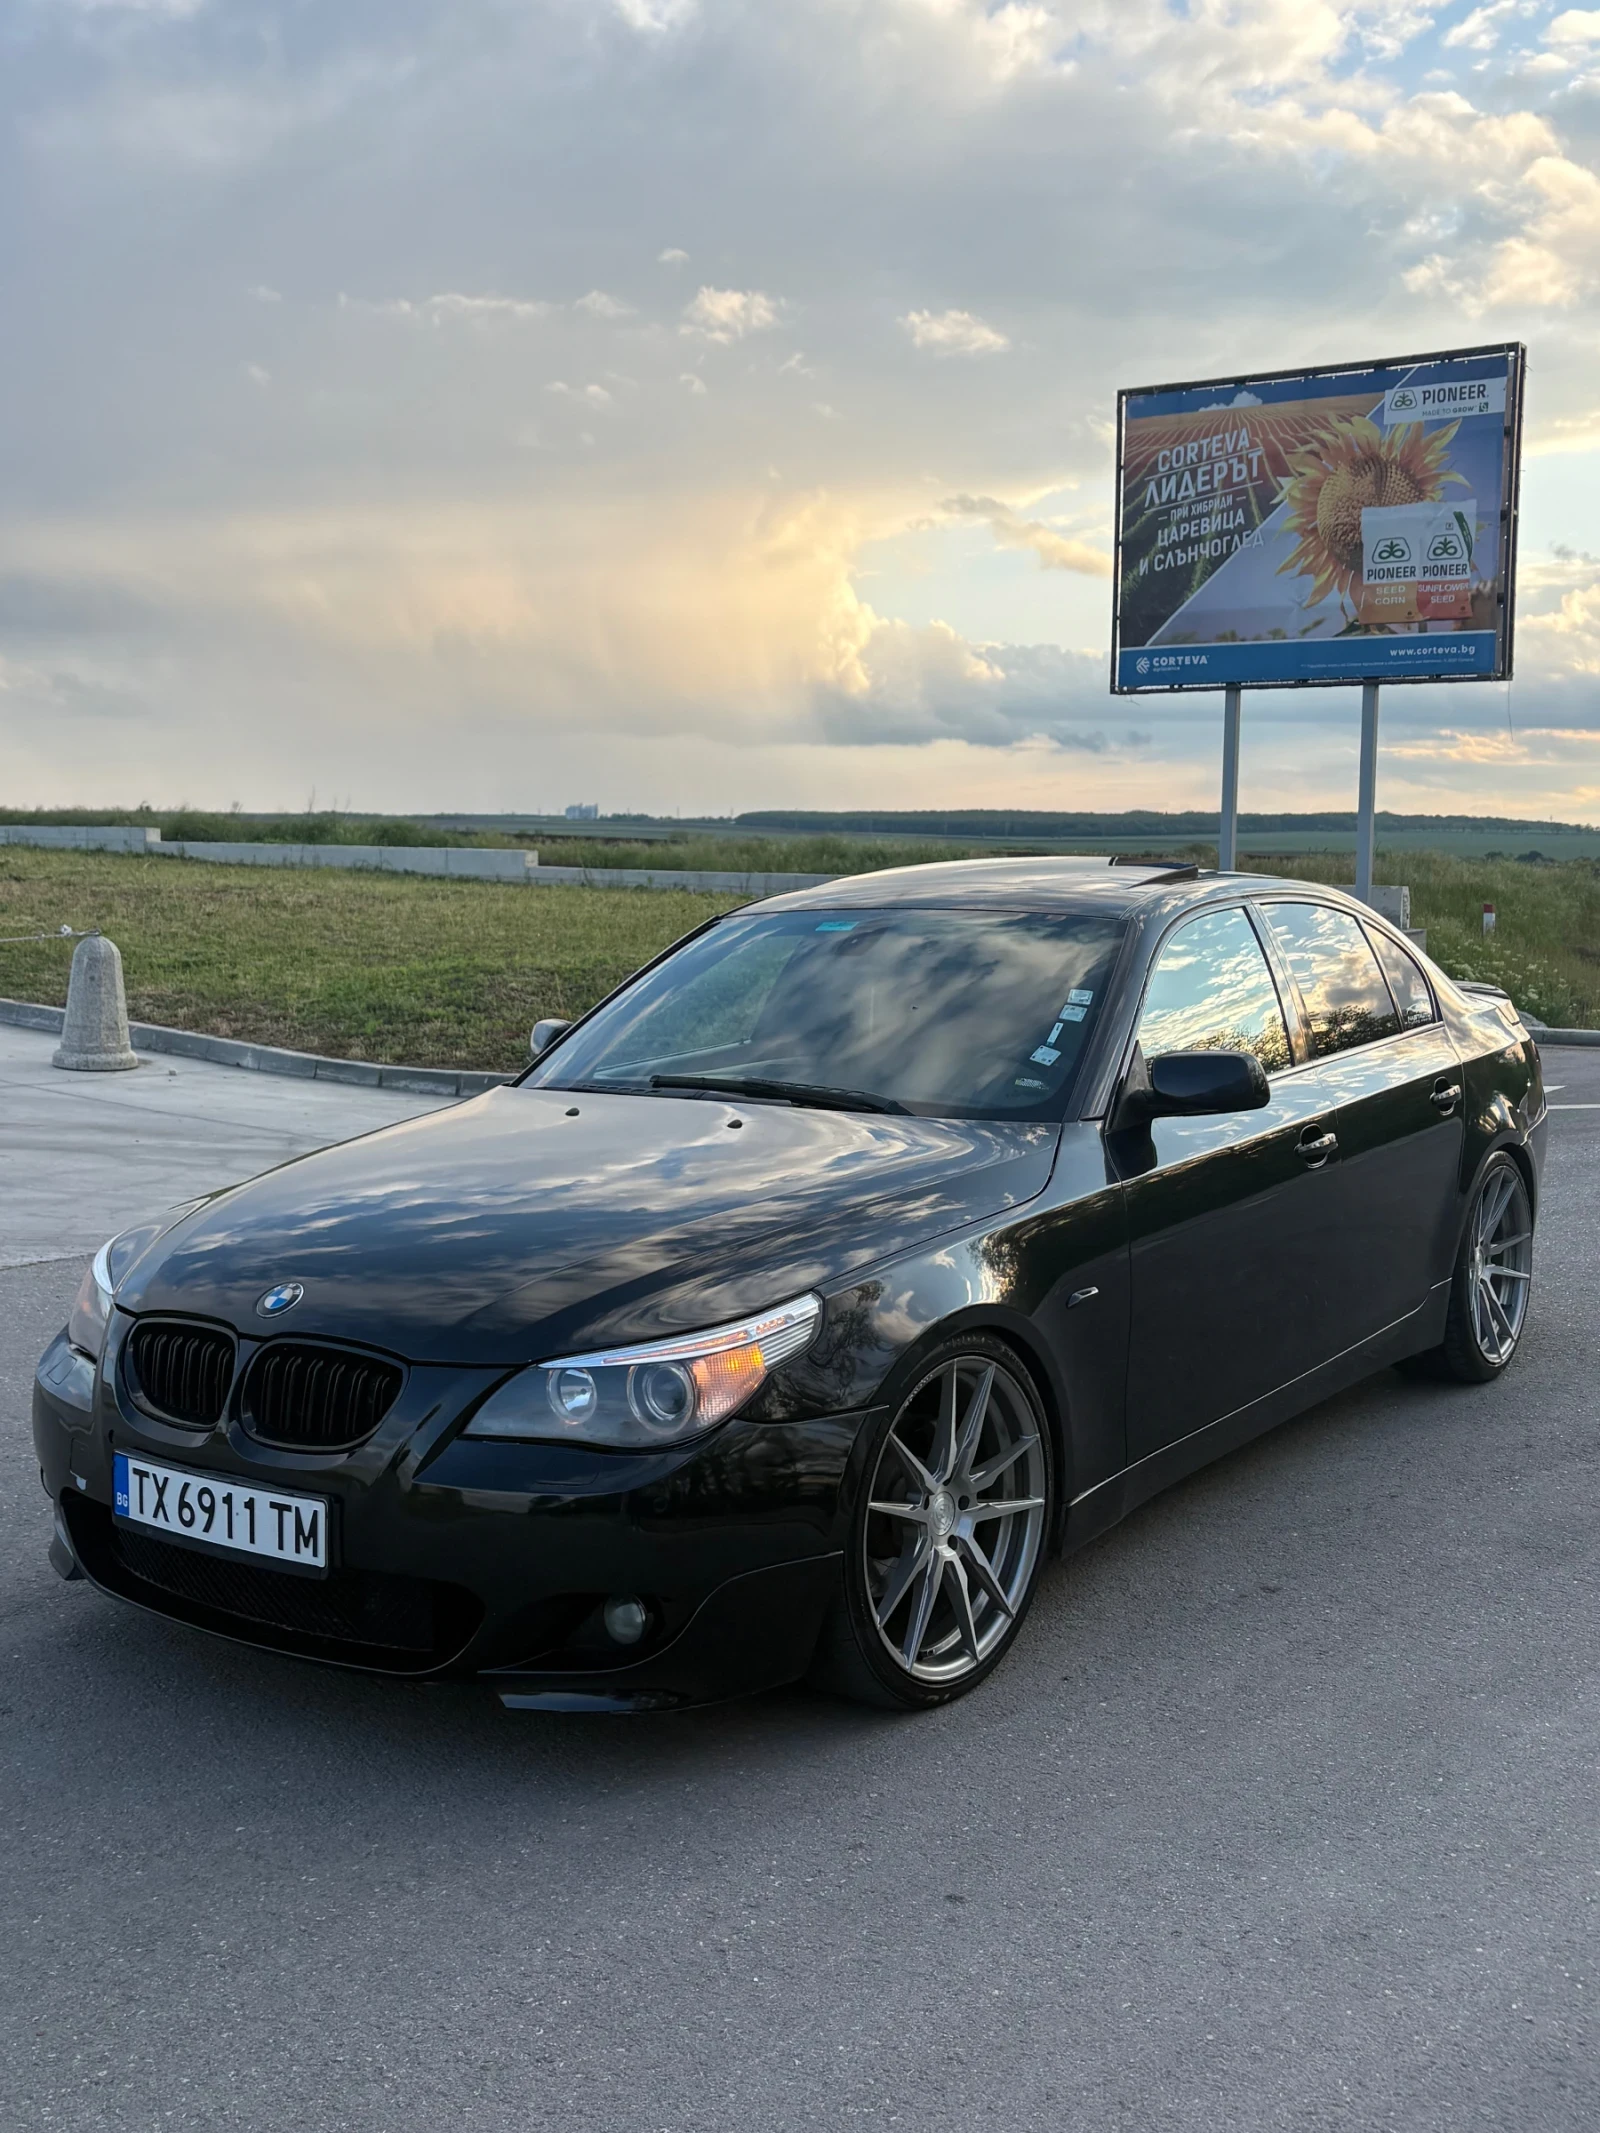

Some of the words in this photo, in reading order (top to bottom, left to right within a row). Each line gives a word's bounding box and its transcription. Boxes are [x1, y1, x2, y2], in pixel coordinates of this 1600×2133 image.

[1422, 383, 1486, 405] PIONEER
[1157, 427, 1250, 473] CORTEVA
[1144, 449, 1263, 508] ЛИДЕРЪТ
[1170, 507, 1189, 521] ПРИ
[1190, 494, 1233, 516] ХИБРИДИ
[1157, 508, 1245, 548] ЦАРЕВИЦА
[1139, 557, 1149, 576] И
[1154, 529, 1264, 572] СЛЪНЧОГЛЕД
[1366, 565, 1417, 581] PIONEER
[1422, 563, 1468, 577] PIONEER
[1376, 584, 1406, 595] SEED
[1374, 596, 1406, 605] CORN
[1430, 594, 1455, 604] SEED
[1389, 644, 1476, 657] www.corteva.bg
[1152, 654, 1208, 666] CORTEVA
[116, 1491, 129, 1508] BG
[132, 1467, 170, 1523] TX
[178, 1481, 256, 1545] 6911
[269, 1501, 319, 1558] TM
